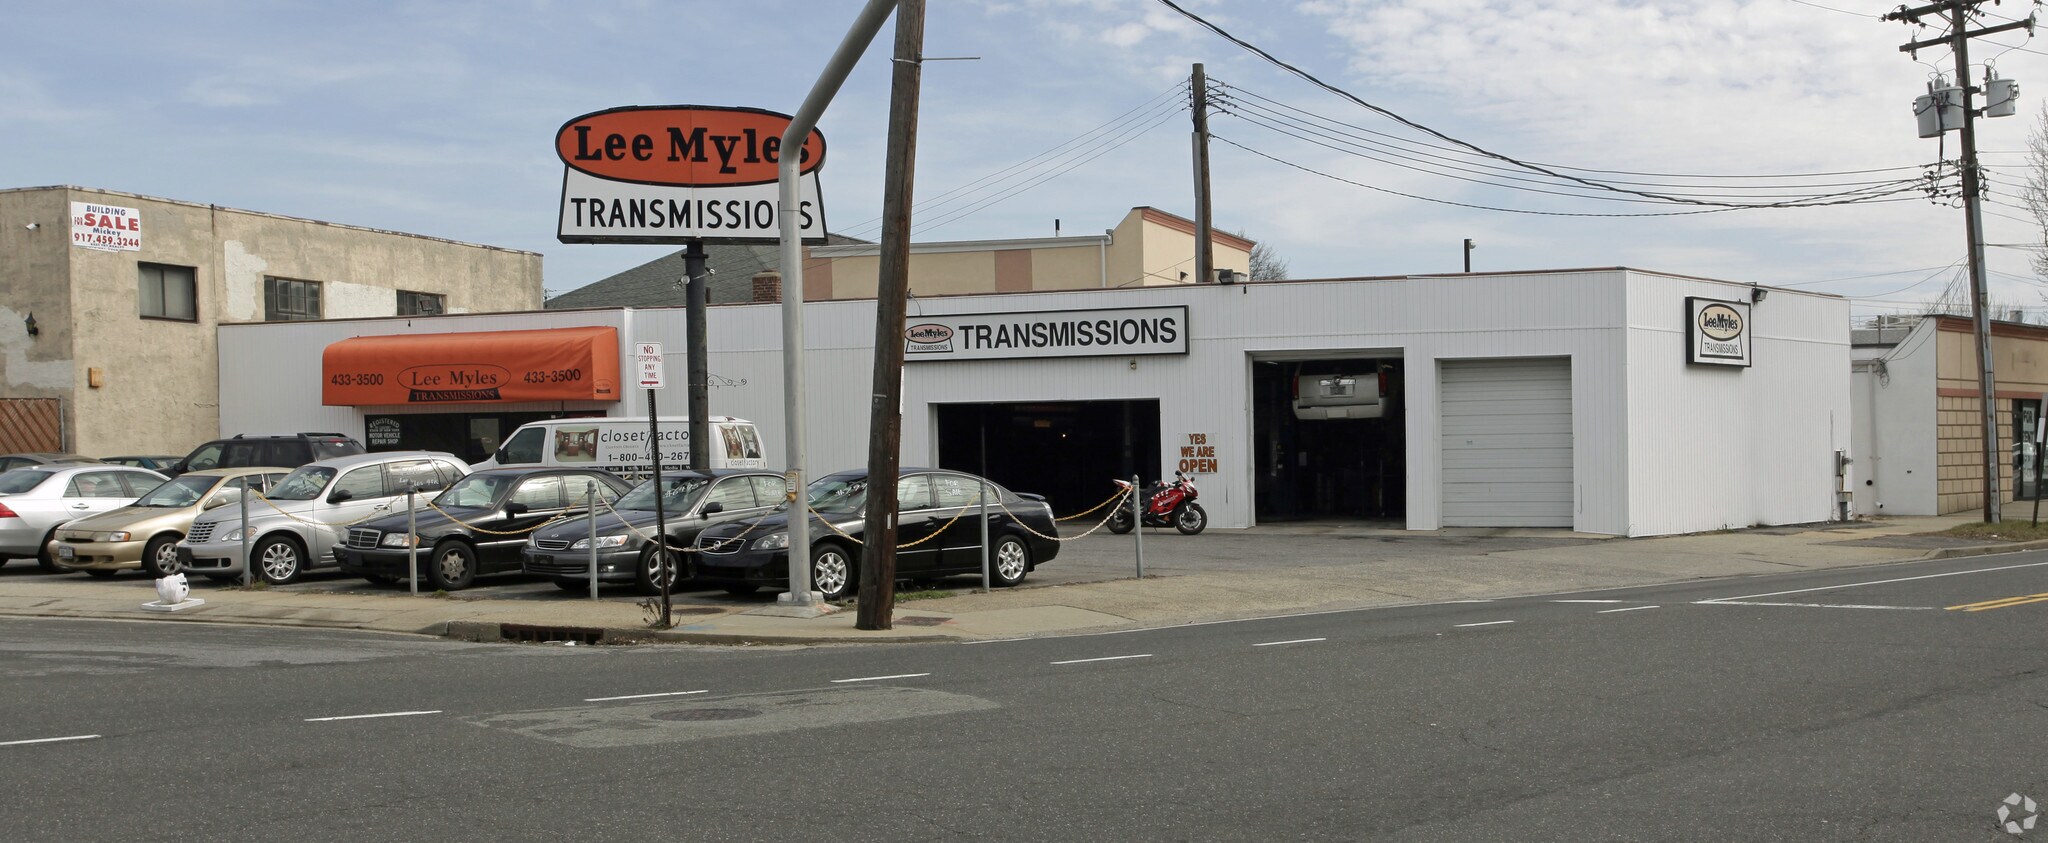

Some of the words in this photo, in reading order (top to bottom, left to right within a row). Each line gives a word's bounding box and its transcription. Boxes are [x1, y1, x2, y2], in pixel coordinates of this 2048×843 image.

[574, 125, 655, 161] Lee
[86, 205, 126, 216] BUILDING
[570, 197, 813, 230] TRANSMISSIOS
[84, 213, 139, 231] SALE
[93, 228, 121, 236] Mickey
[74, 233, 139, 247] 917.459.3244
[959, 317, 1178, 350] TRANSMISSIONS
[643, 345, 654, 354] NO
[910, 343, 948, 351] TRANSMISSIONS
[1704, 342, 1739, 355] TRANSMISSIONS
[331, 373, 384, 386] 433-3500
[412, 371, 441, 386] Lee
[449, 369, 497, 389] Myles
[523, 368, 582, 384] 433-3500
[414, 390, 495, 401] TRANSMISSIONS
[369, 418, 400, 428] REGISTERED
[1188, 433, 1207, 445] YES
[608, 451, 689, 462] 1-800-40-267
[1180, 446, 1195, 458] WE
[1196, 446, 1215, 458] ARE
[1179, 458, 1218, 473] OPEN
